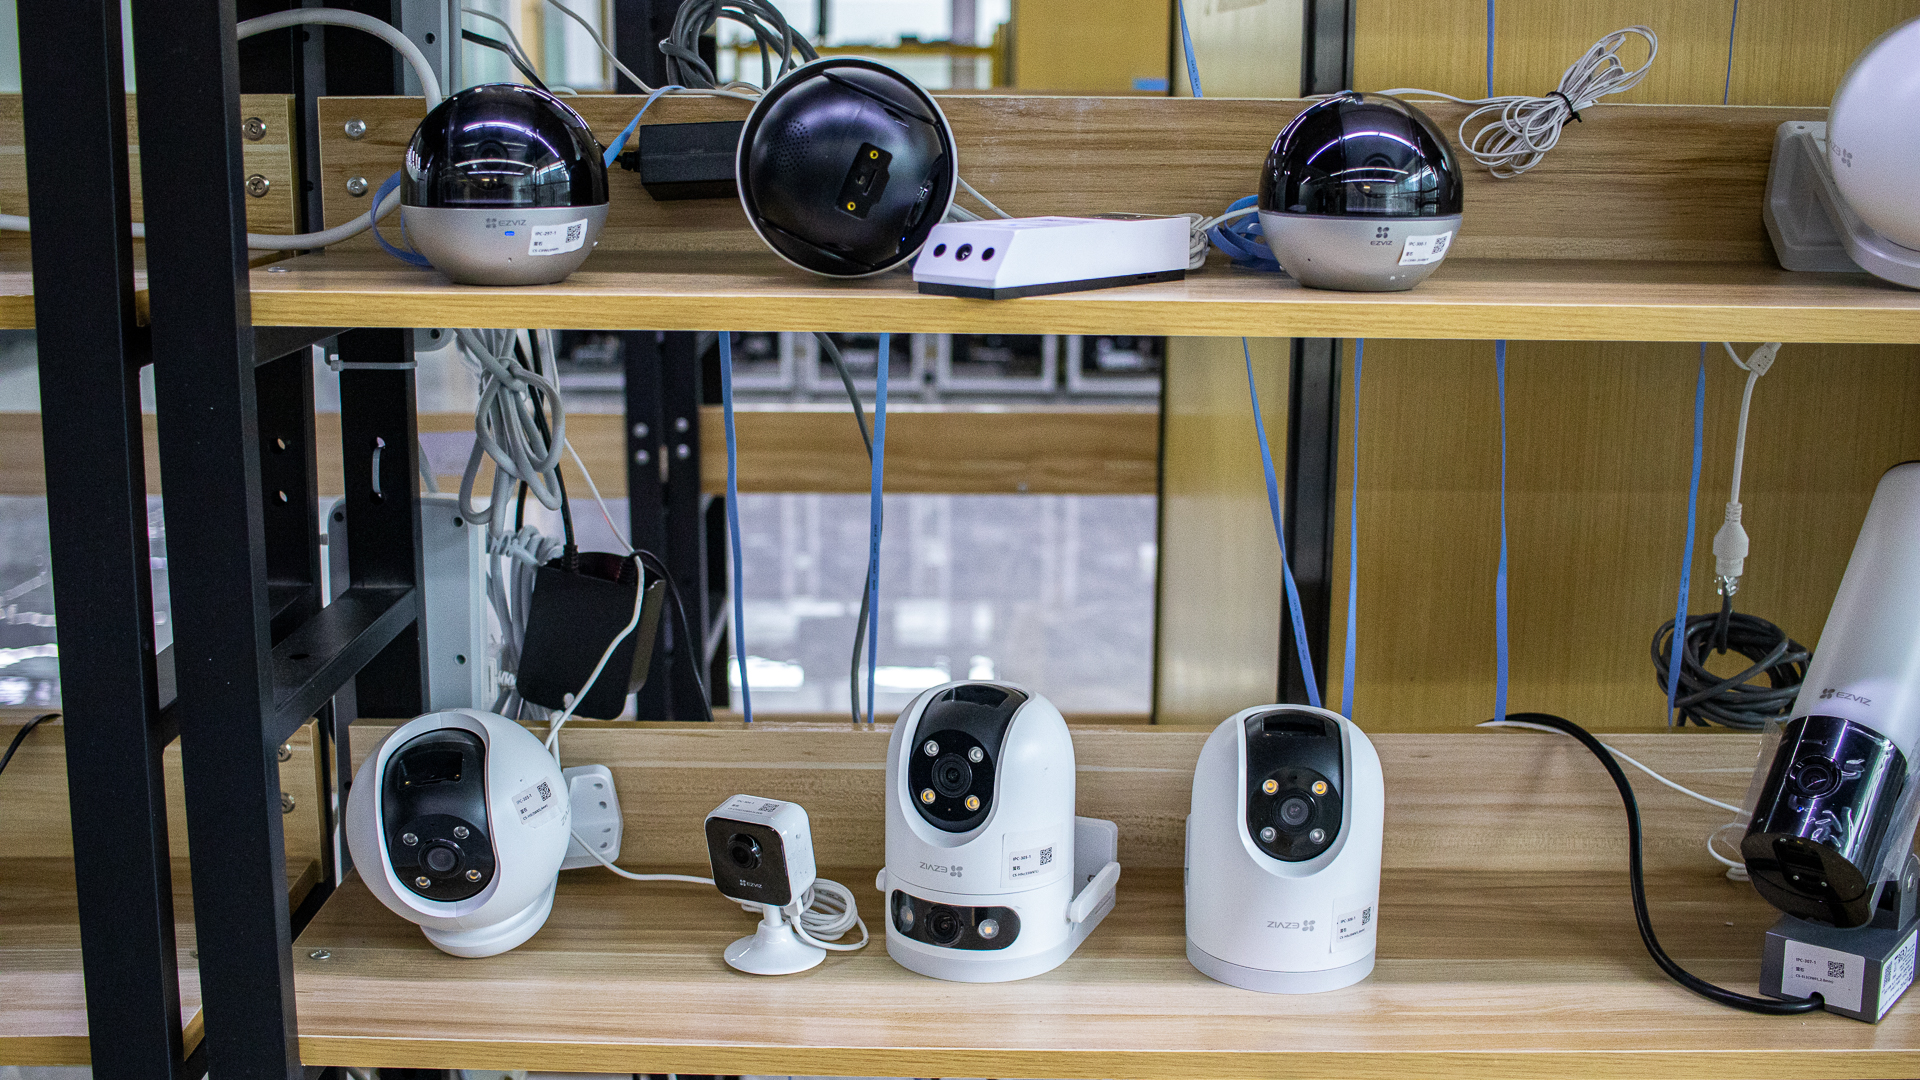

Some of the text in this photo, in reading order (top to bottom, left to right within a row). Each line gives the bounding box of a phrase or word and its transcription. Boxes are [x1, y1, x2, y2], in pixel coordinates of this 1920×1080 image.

[498, 219, 527, 227] EZVIZ
[1836, 691, 1872, 706] EZVIZ
[919, 861, 948, 874] EZVIZ
[746, 881, 763, 889] EZVIZ
[1266, 920, 1300, 930] EZVIZ
